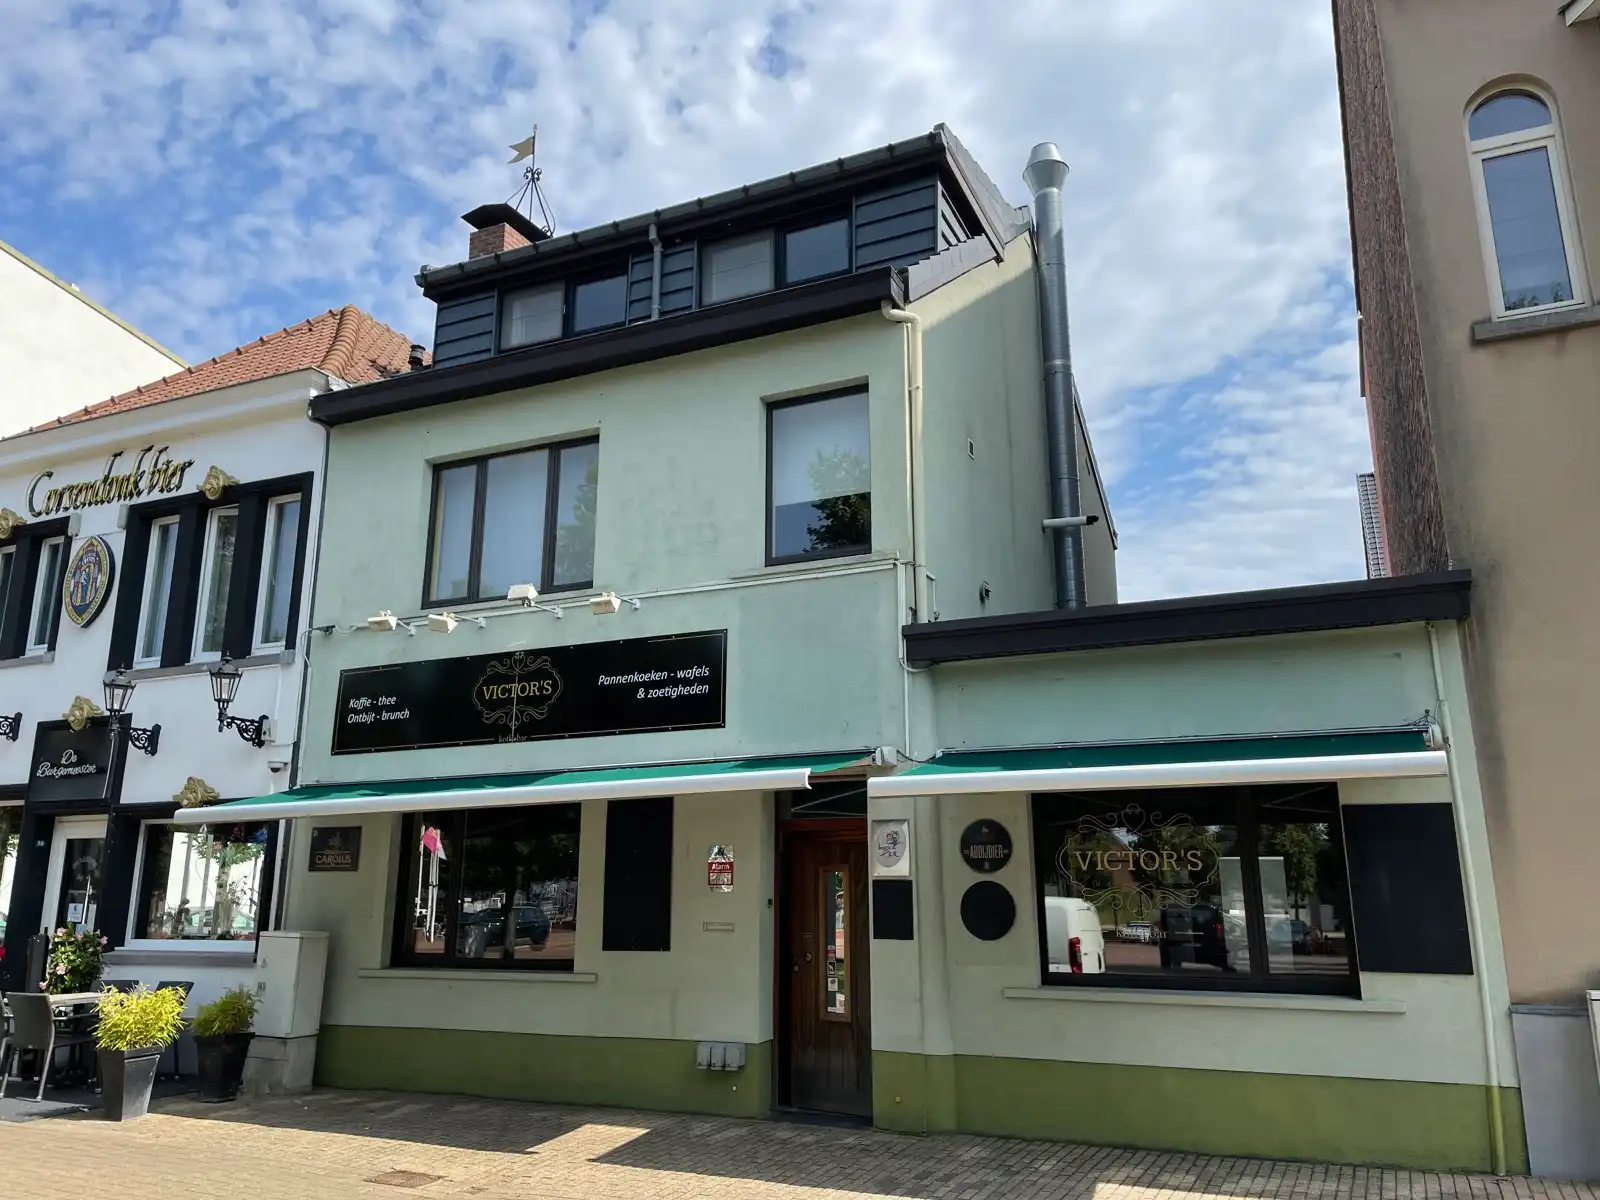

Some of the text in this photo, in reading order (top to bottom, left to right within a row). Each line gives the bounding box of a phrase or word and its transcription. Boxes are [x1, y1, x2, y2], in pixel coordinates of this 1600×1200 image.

[147, 446, 195, 495] bier
[598, 667, 668, 686] Pannenkoeken
[677, 665, 710, 680] wafels
[482, 680, 552, 700] VICTOR'S
[637, 683, 709, 698] & zoetigheden
[349, 697, 372, 710] Koffie
[378, 695, 397, 705] thee
[347, 712, 375, 724] Ontbijt
[381, 708, 410, 720] brunch
[61, 749, 77, 764] De
[970, 844, 1004, 859] ABDIJBIER
[316, 854, 352, 865] CAROLUS
[1074, 850, 1203, 871] VICTOR'S
